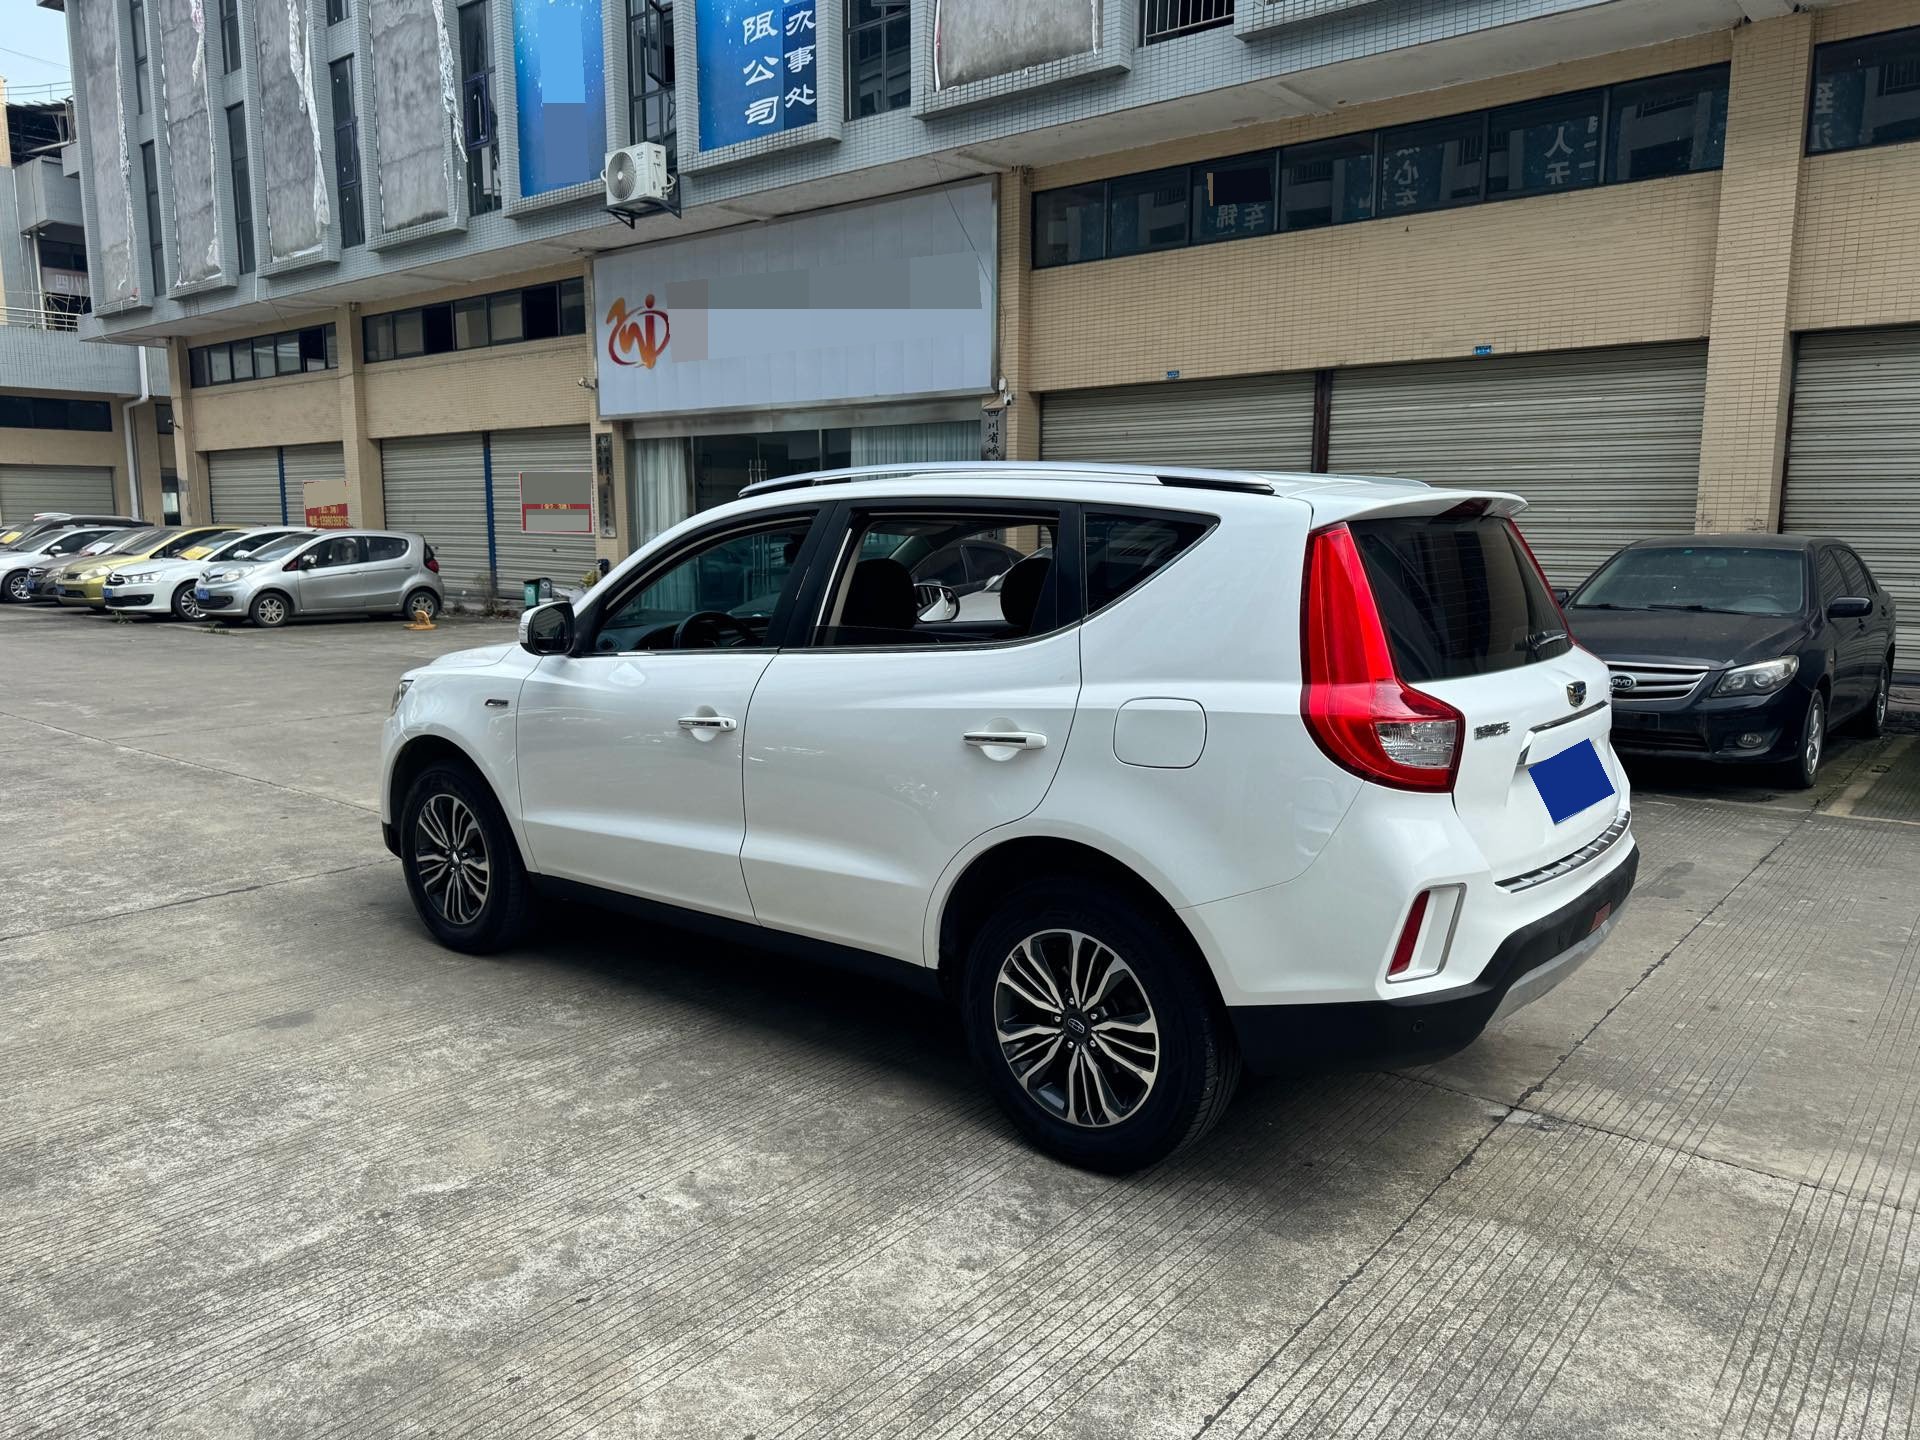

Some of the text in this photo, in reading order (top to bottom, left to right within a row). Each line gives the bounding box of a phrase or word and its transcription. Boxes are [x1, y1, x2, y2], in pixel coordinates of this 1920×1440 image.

[784, 9, 817, 108] 办事处
[985, 409, 1000, 461] 四川省峨
